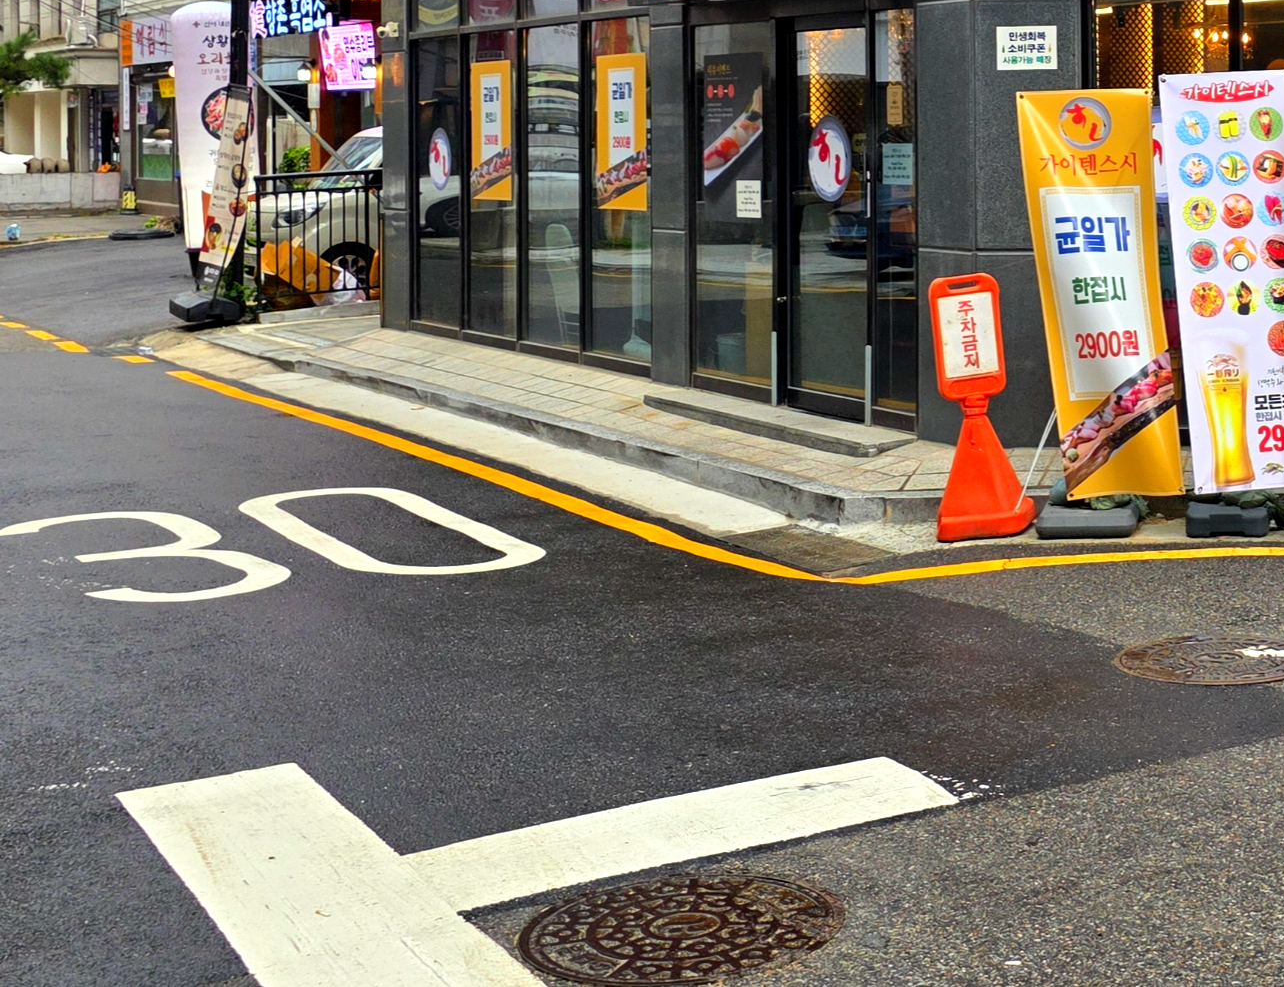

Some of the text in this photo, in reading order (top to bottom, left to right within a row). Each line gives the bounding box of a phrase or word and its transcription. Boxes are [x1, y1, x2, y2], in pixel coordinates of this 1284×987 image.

[1008, 31, 1046, 42] 민생회복
[1007, 43, 1046, 53] 소비쿠폰
[1002, 55, 1052, 65] 사용가능 매장
[483, 86, 500, 103] 균일가
[612, 81, 633, 100] 균일가
[1184, 80, 1270, 101] 가이텐스시
[483, 134, 499, 146] 2900원
[612, 136, 632, 148] 2900원
[1039, 152, 1137, 176] 가이텐스시
[1054, 216, 1130, 255] 균일가
[1072, 276, 1127, 305] 한접시
[957, 299, 980, 369] 주차금지
[1075, 329, 1140, 359] 2900원
[1255, 410, 1282, 422] 한접시
[0, 487, 546, 602] 30
